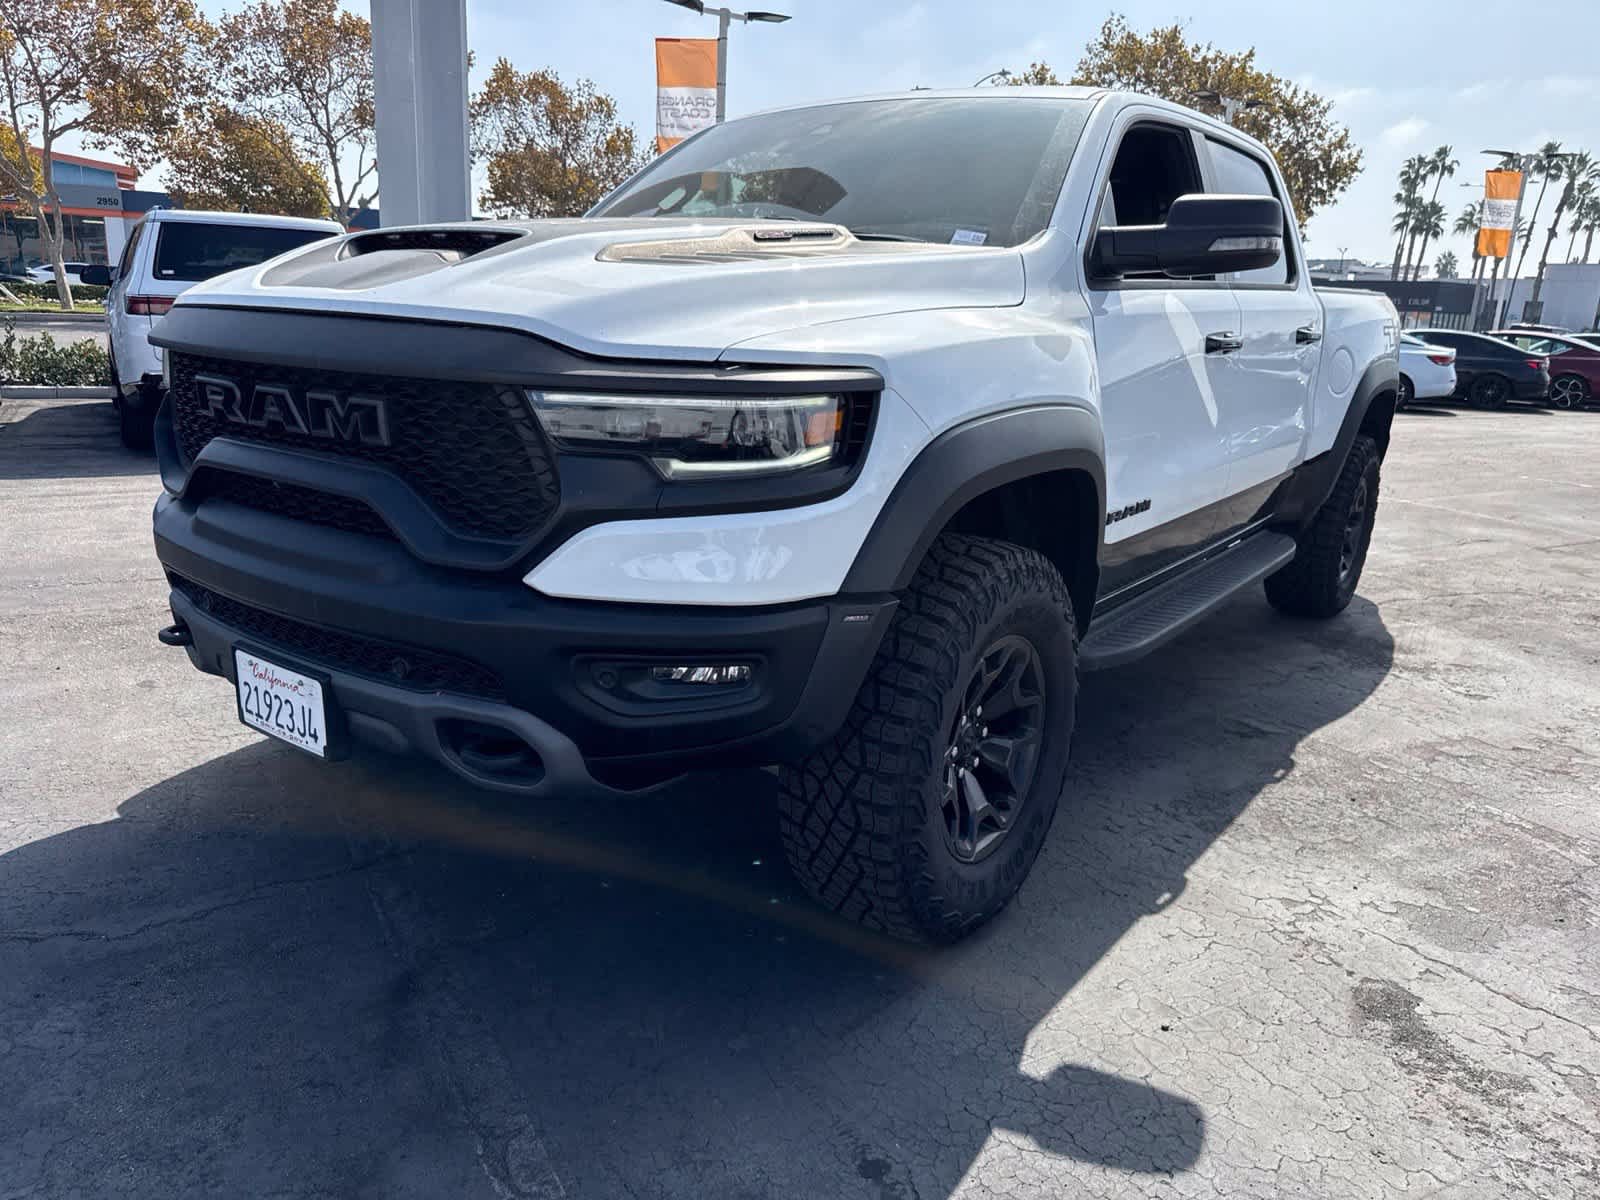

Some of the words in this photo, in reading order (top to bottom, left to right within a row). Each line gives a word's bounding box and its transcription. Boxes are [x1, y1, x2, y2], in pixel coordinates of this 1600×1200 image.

[97, 197, 119, 206] 2950
[195, 375, 391, 446] RAM
[1105, 499, 1151, 526] RAM
[252, 662, 304, 697] California
[243, 681, 319, 744] 21923J4
